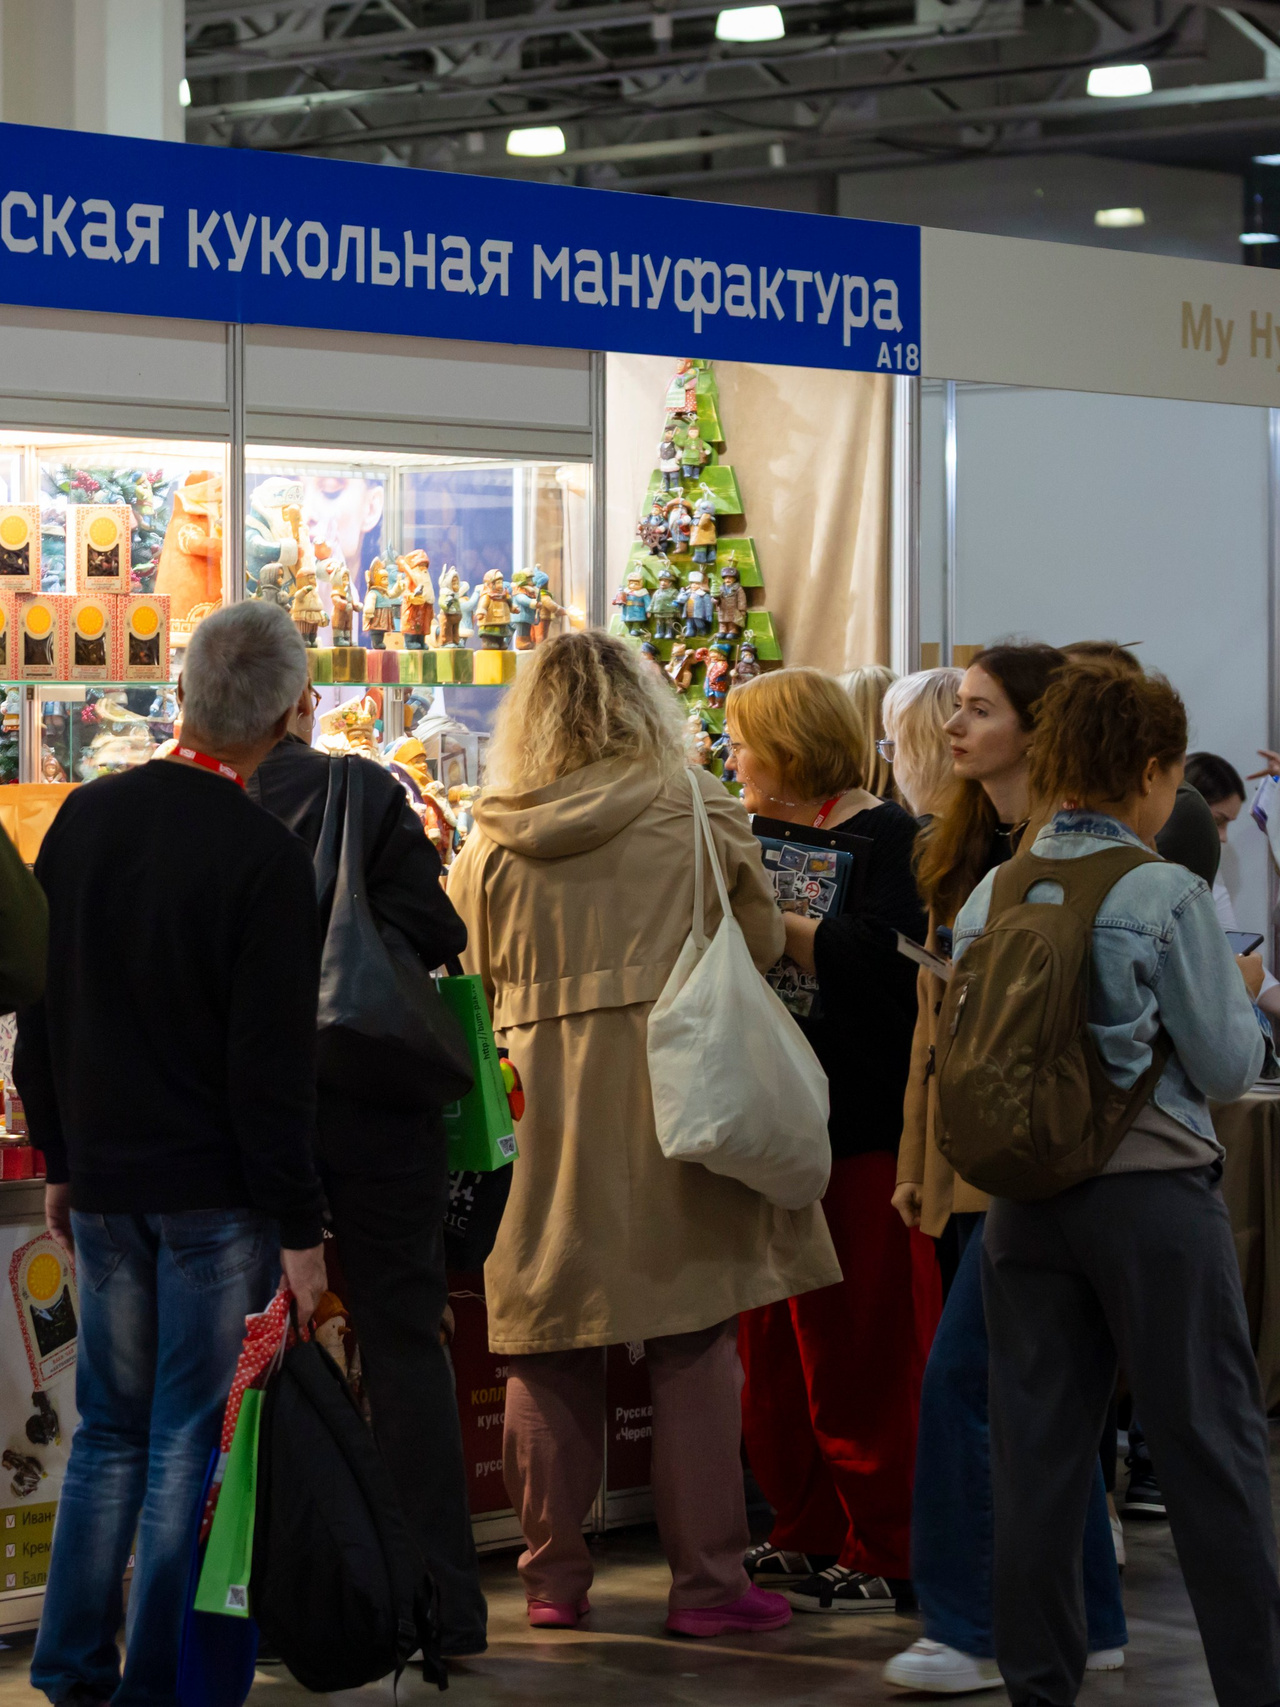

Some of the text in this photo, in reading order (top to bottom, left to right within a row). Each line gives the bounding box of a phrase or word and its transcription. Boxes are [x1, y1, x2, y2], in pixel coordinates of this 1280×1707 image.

[187, 208, 514, 297] кукольная
[532, 244, 904, 347] мануфактура
[876, 341, 920, 371] A18
[1181, 300, 1235, 367] My
